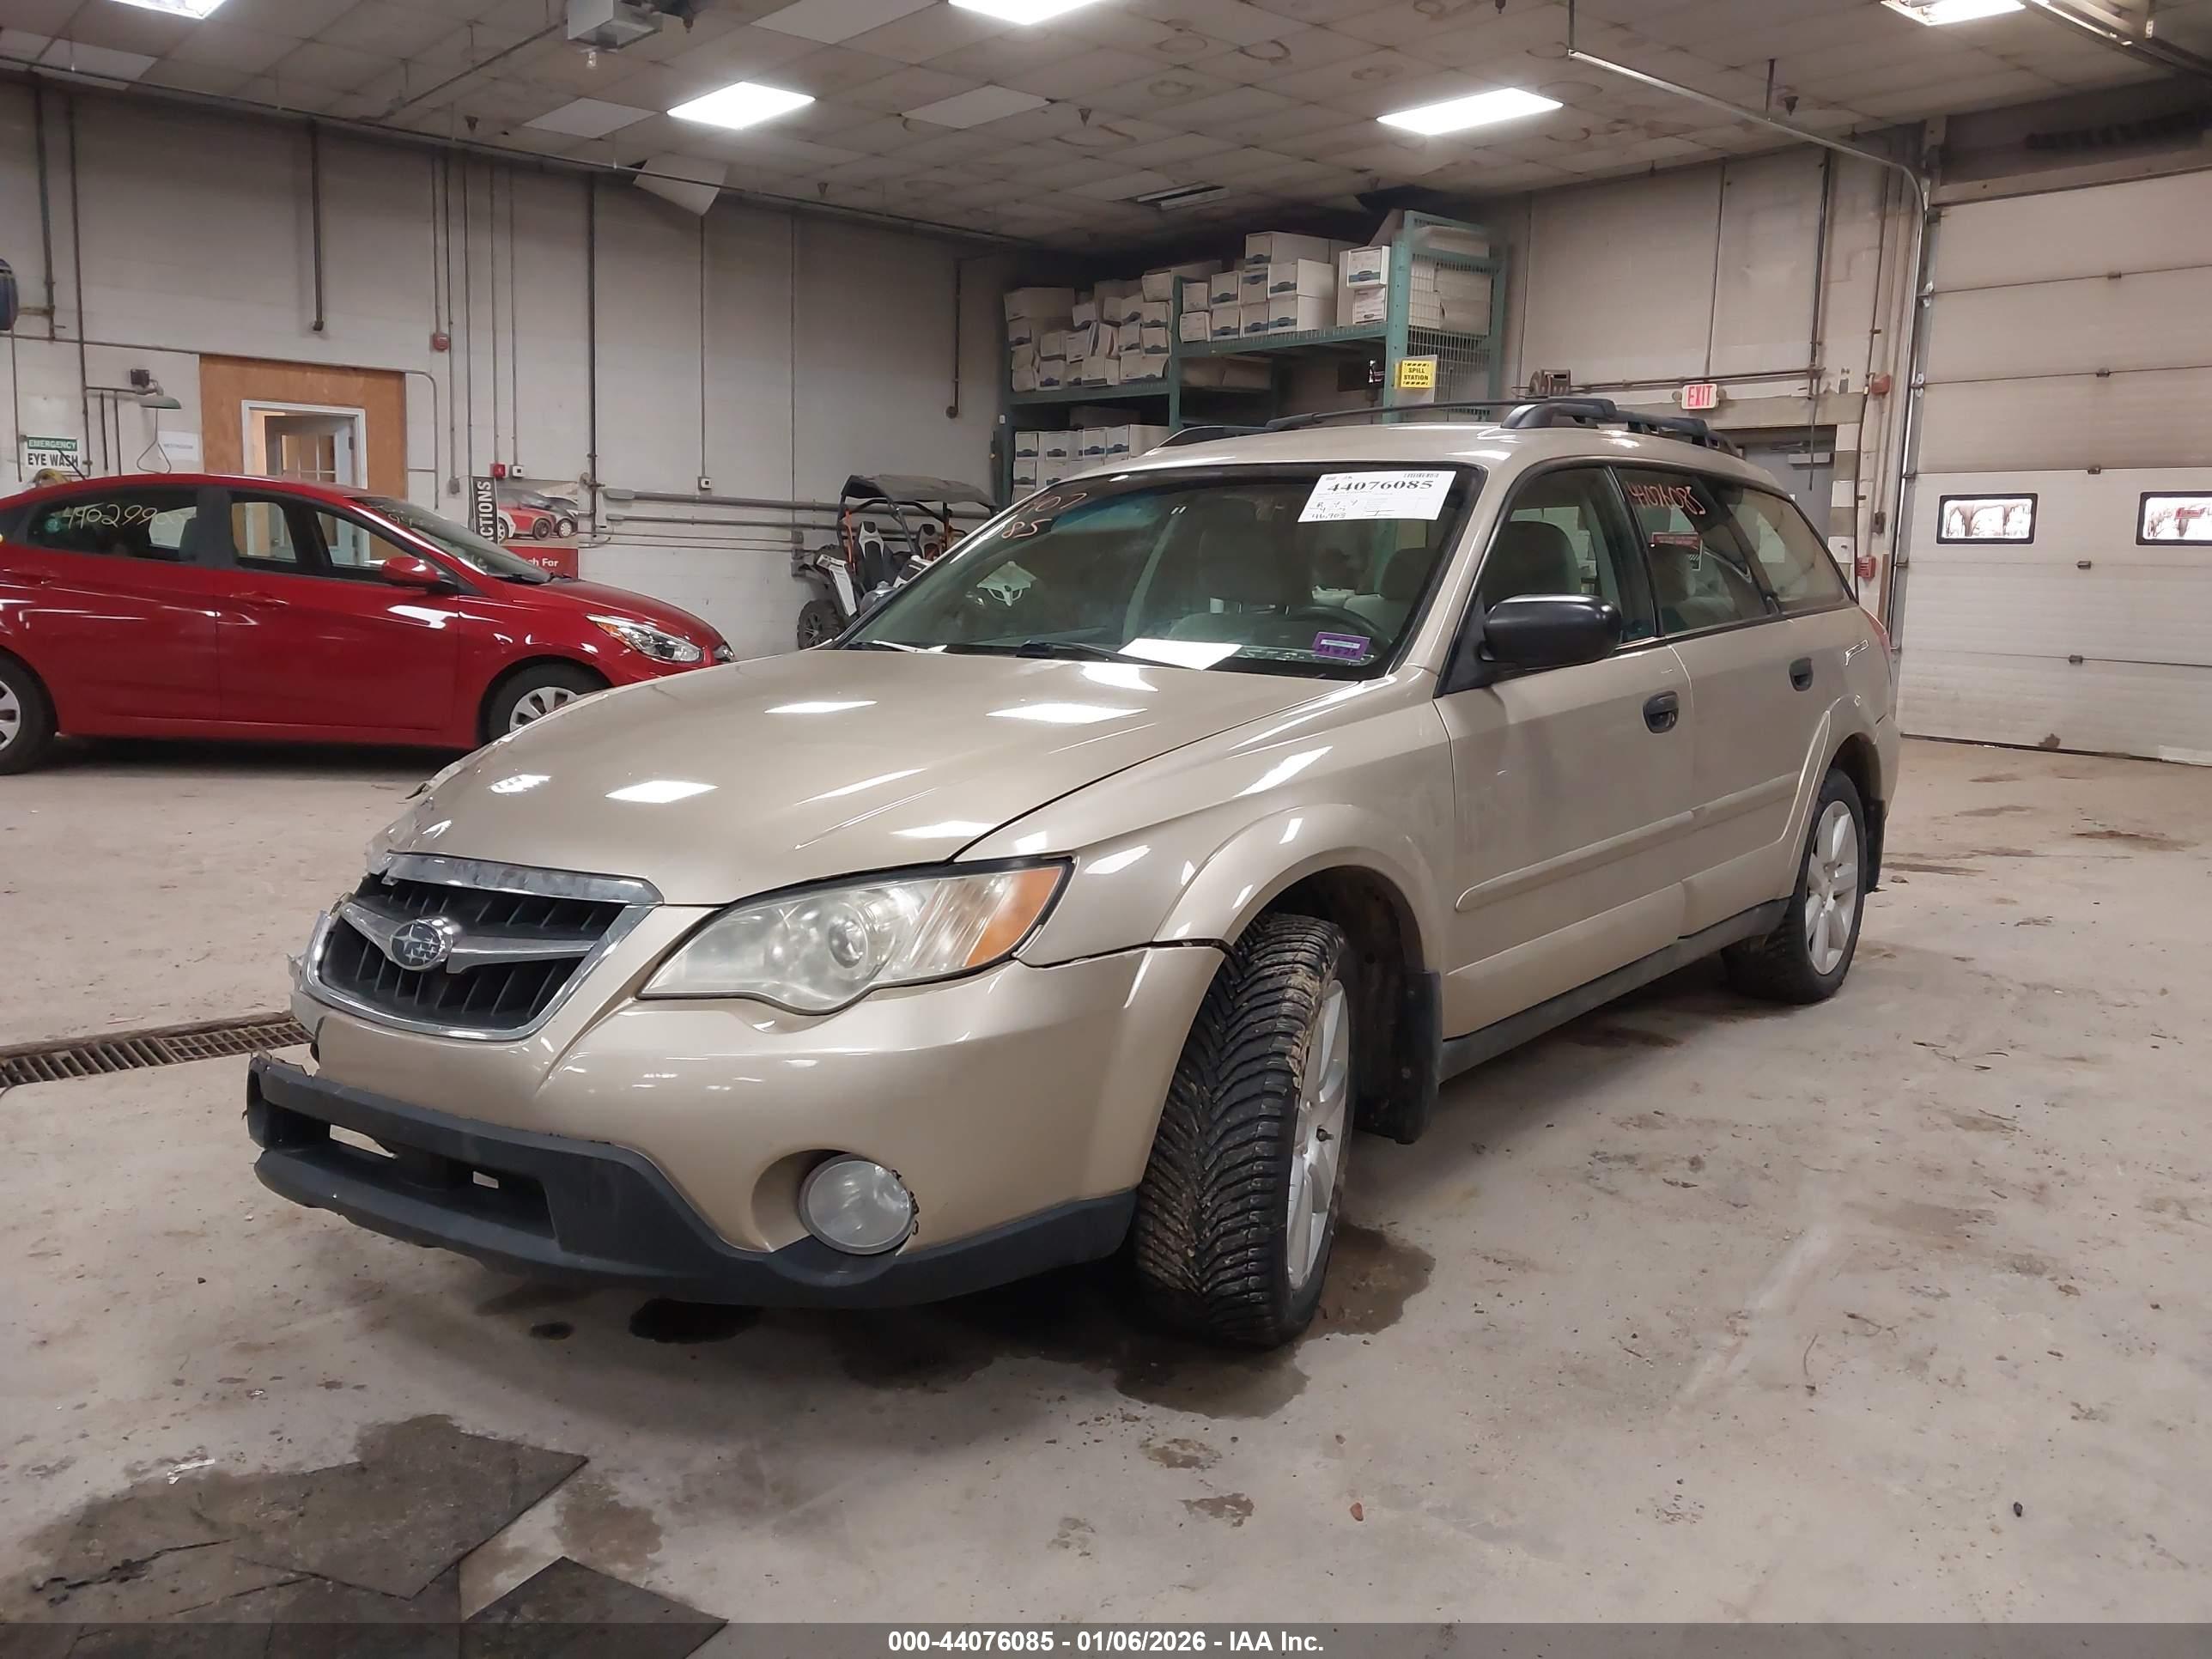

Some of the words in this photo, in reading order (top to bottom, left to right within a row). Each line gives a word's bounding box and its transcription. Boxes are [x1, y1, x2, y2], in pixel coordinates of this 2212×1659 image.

[1687, 386, 1713, 407] EXIT
[28, 439, 76, 449] EMERGENCY
[27, 453, 48, 465] EYE
[50, 453, 79, 467] WASH
[1328, 480, 1434, 492] 44076085
[477, 481, 495, 541] CTIONS
[542, 557, 559, 567] For
